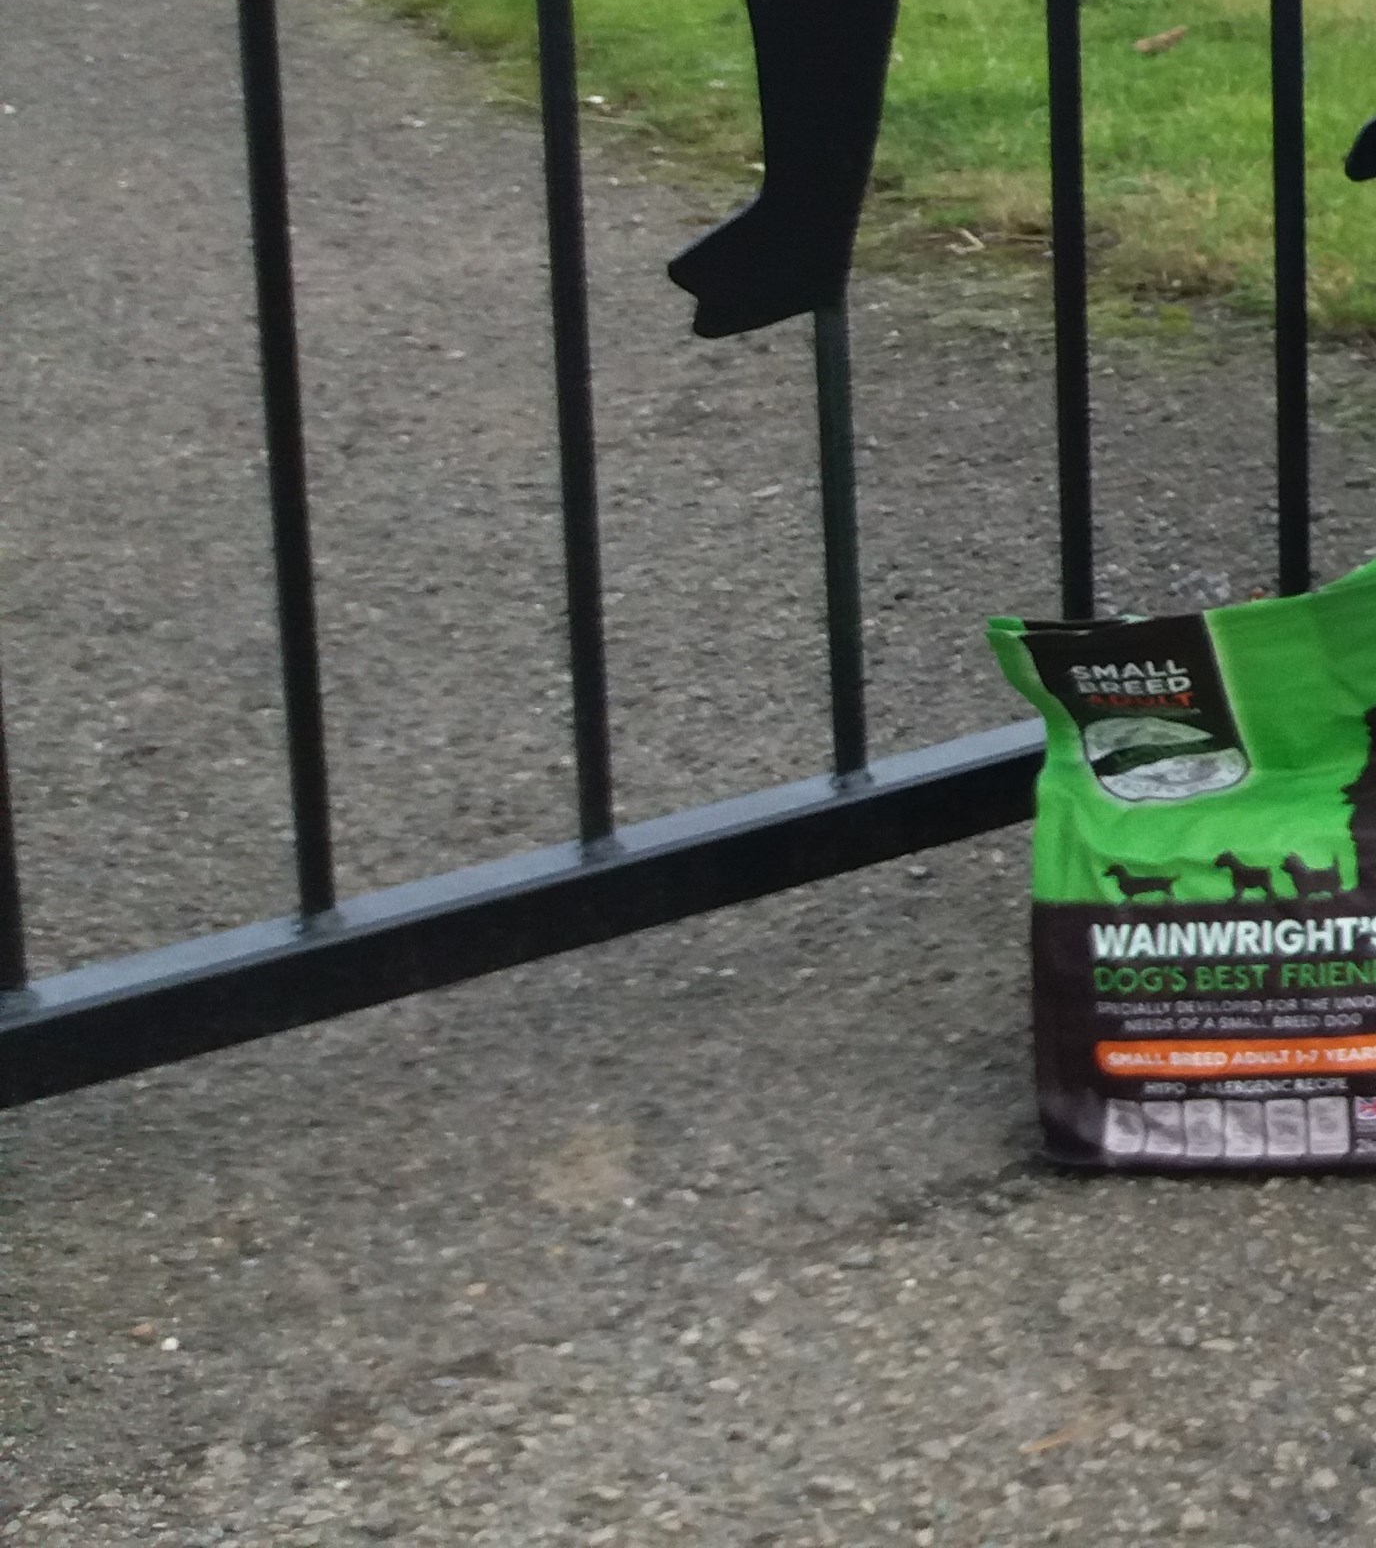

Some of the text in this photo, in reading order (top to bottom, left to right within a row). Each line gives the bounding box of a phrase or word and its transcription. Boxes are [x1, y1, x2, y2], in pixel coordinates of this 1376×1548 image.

[1070, 659, 1189, 680] SMALL
[1077, 676, 1192, 695] BREED
[1093, 965, 1188, 994] DOG'S
[1194, 963, 1271, 992] BEST
[1203, 1016, 1216, 1028] A
[1323, 1013, 1363, 1028] DOG
[1107, 1051, 1165, 1066] SMALL
[1169, 1051, 1228, 1067] BREED
[1231, 1049, 1289, 1064] ADULT
